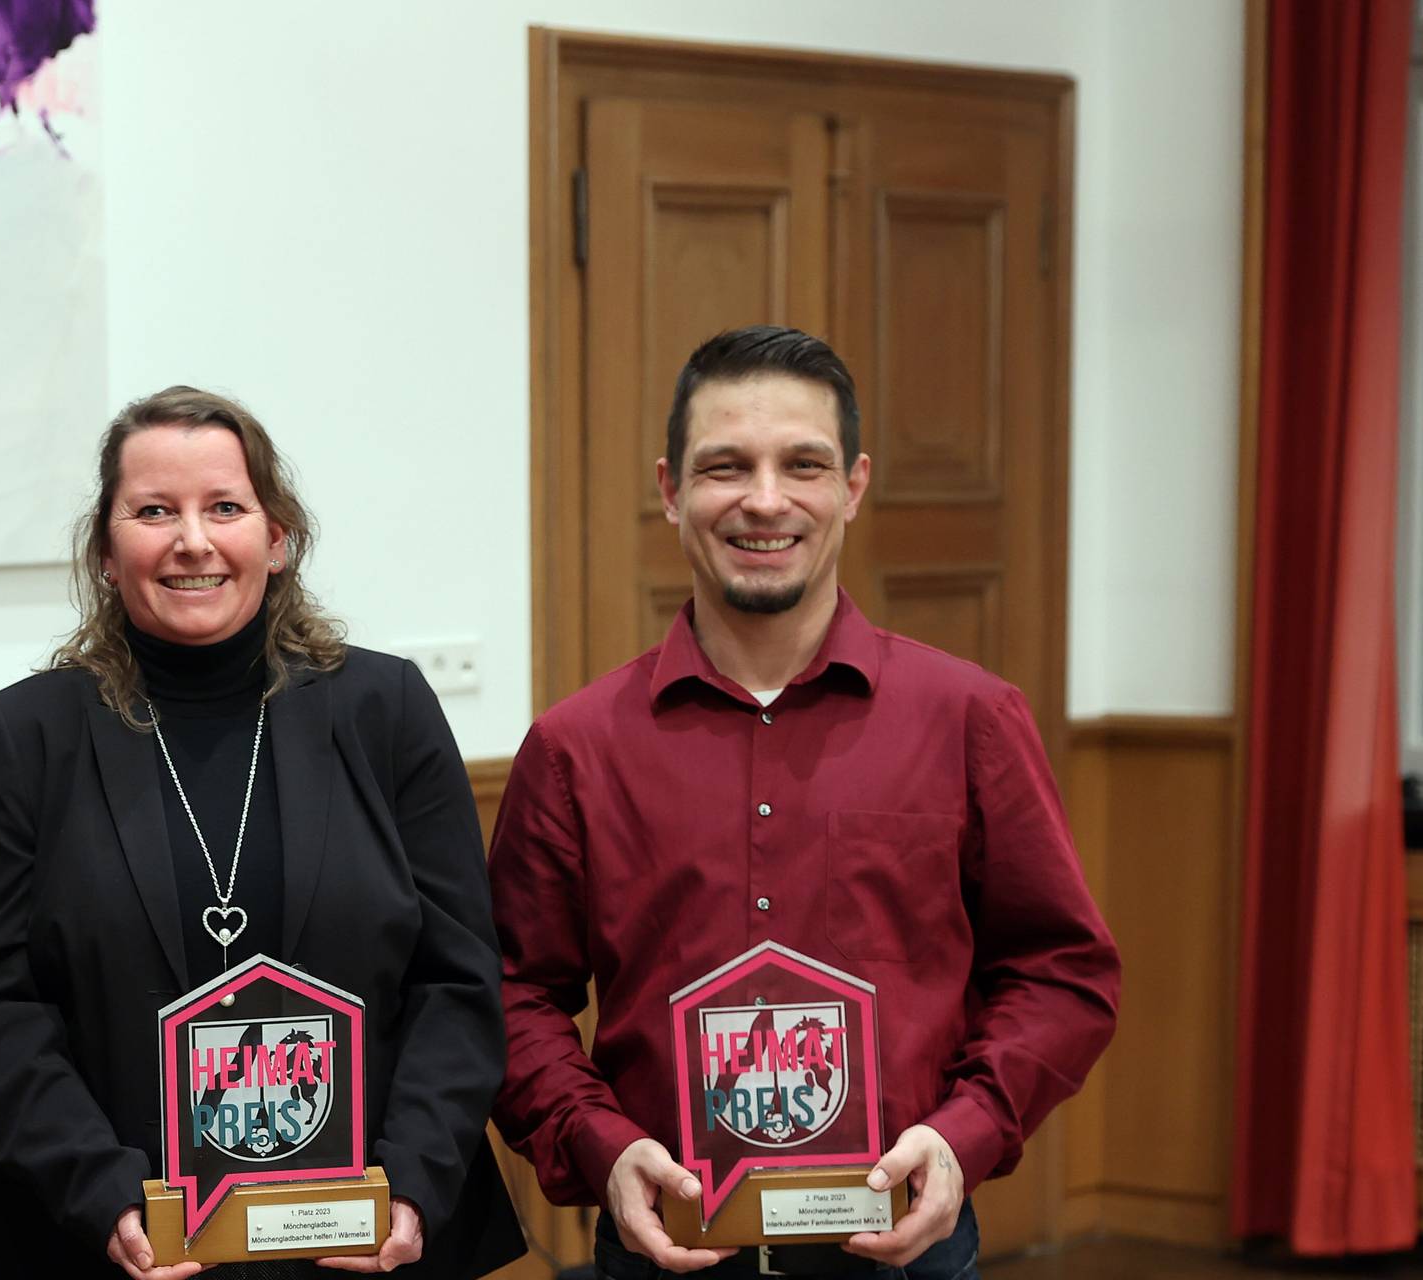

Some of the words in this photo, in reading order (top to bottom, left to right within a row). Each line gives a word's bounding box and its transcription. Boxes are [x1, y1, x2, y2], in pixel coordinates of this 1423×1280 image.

[192, 1041, 337, 1091] HEIMAT
[700, 1026, 847, 1076] HEIMAT
[193, 1099, 303, 1147] PREIS
[704, 1084, 815, 1131] PREIS
[283, 1221, 338, 1230] Mönchengladbach
[298, 1208, 314, 1216] Platz
[251, 1233, 313, 1244] Mönchengladbacher
[313, 1232, 333, 1241] helfen
[338, 1230, 371, 1239] Wärmetaxi
